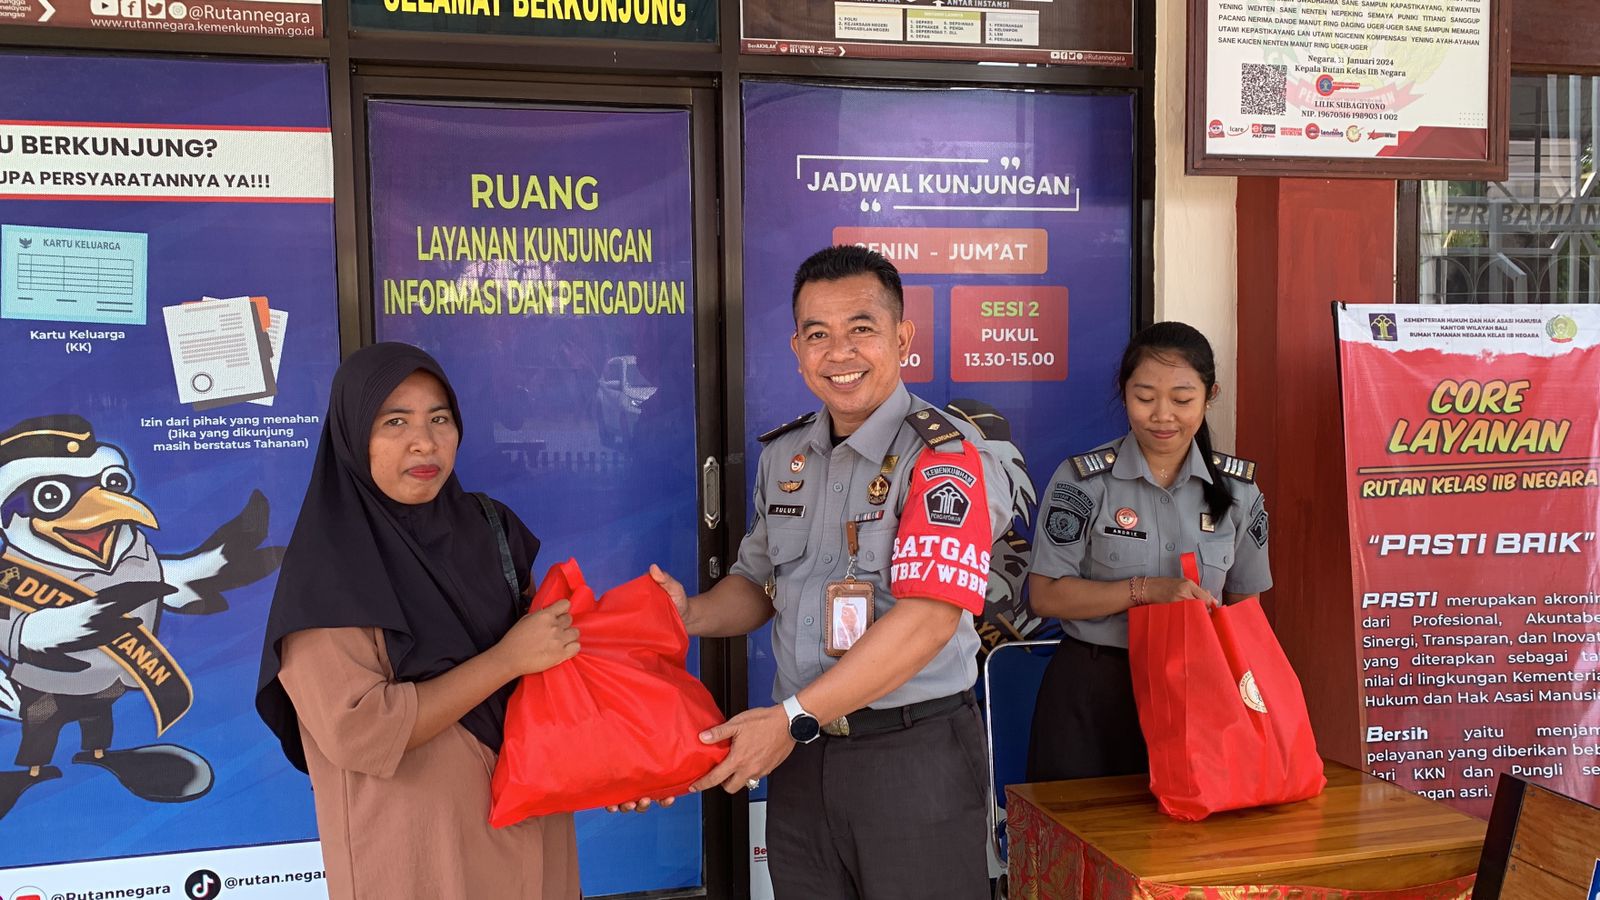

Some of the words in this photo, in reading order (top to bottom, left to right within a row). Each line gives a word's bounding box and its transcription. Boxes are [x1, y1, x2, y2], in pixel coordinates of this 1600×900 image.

[189, 4, 310, 24] @Rutannegara
[91, 18, 315, 38] www.rutannegara.kemenkumham.go.id
[1367, 22, 1404, 31] UGER-UGER
[1242, 28, 1296, 36] KEPASTIKAYANG
[1366, 34, 1407, 42] KOMPENSASI
[1436, 38, 1480, 46] AYAH-AYAHAN
[1346, 57, 1376, 66] Januari
[1377, 58, 1394, 66] 2024
[1295, 66, 1320, 75] Kepala
[1322, 66, 1345, 74] Rutan
[1347, 67, 1366, 75] Kelas
[1368, 68, 1378, 76] IIB
[1380, 68, 1406, 78] Negara
[1314, 100, 1335, 108] LILIK
[1337, 100, 1386, 110] SUBAGIYONO
[1302, 110, 1316, 118] NIP.
[1384, 113, 1398, 121] 002
[22, 135, 218, 158] BERKUNJUNG?
[40, 171, 220, 189] PERSYARATANNYA
[224, 174, 270, 189] YA!!!
[807, 170, 913, 194] JADWAL
[918, 173, 1070, 196] KUNJUNGAN
[471, 174, 599, 210] RUANG
[43, 238, 73, 249] KARTU
[76, 239, 121, 251] KELUARGA
[416, 226, 518, 261] LAYANAN
[524, 227, 652, 263] KUNJUNGAN
[854, 242, 919, 260] ENIN
[384, 280, 502, 314] INFORMASI
[510, 280, 553, 314] DAN
[558, 280, 685, 314] PENGADUAN
[980, 302, 1024, 318] SESI
[1028, 301, 1040, 318] 2
[30, 330, 66, 340] Kartu
[69, 330, 126, 342] Keluarga
[981, 328, 1039, 343] PUKUL
[65, 342, 92, 354] (KK)
[964, 352, 1055, 367] 13.30-15.00
[1430, 379, 1531, 415] CORE
[140, 418, 163, 428] Izin
[166, 416, 190, 427] dari
[193, 416, 227, 428] pihak
[230, 416, 260, 428] yang
[263, 414, 320, 425] menahan
[168, 428, 197, 440] (Jika
[200, 429, 230, 440] yang
[232, 426, 294, 440] dikunjung
[1387, 419, 1572, 456] LAYANAN
[153, 441, 191, 452] masih
[194, 440, 251, 452] berstatus
[253, 438, 310, 450] Tahanan)
[1362, 478, 1426, 499] RUTAN
[1432, 476, 1487, 496] KELAS
[1492, 474, 1516, 492] IIB
[1522, 469, 1599, 490] NEGARA
[775, 506, 797, 514] TULUS
[892, 536, 990, 575] SATGAS
[1362, 591, 1438, 609] PASTI
[1446, 594, 1536, 609] merupakan
[1362, 615, 1390, 628] dari
[1413, 613, 1502, 628] Profesional,
[1362, 634, 1419, 650] Sinergi,
[1423, 634, 1513, 648] Transparan,
[1518, 631, 1548, 645] dan
[1363, 656, 1400, 671] yang
[1412, 652, 1496, 668] diterapkan
[1508, 650, 1568, 666] sebagai
[1364, 674, 1394, 688] nilai
[1400, 673, 1413, 687] di
[1418, 672, 1507, 688] lingkungan
[1366, 693, 1419, 708] Hukum
[1424, 692, 1453, 706] dan
[1458, 690, 1489, 704] Hak
[1494, 690, 1534, 704] Asasi
[1366, 725, 1428, 743] Bersih
[1464, 725, 1504, 741] yaitu
[1367, 748, 1444, 765] pelayanan
[1448, 747, 1488, 762] yang
[1492, 744, 1568, 758] diberikan
[1414, 767, 1446, 780] KKN
[1463, 765, 1494, 778] dan
[1512, 764, 1564, 778] Pungli
[1460, 786, 1493, 798] asri.
[50, 884, 171, 900] @Rutannegara
